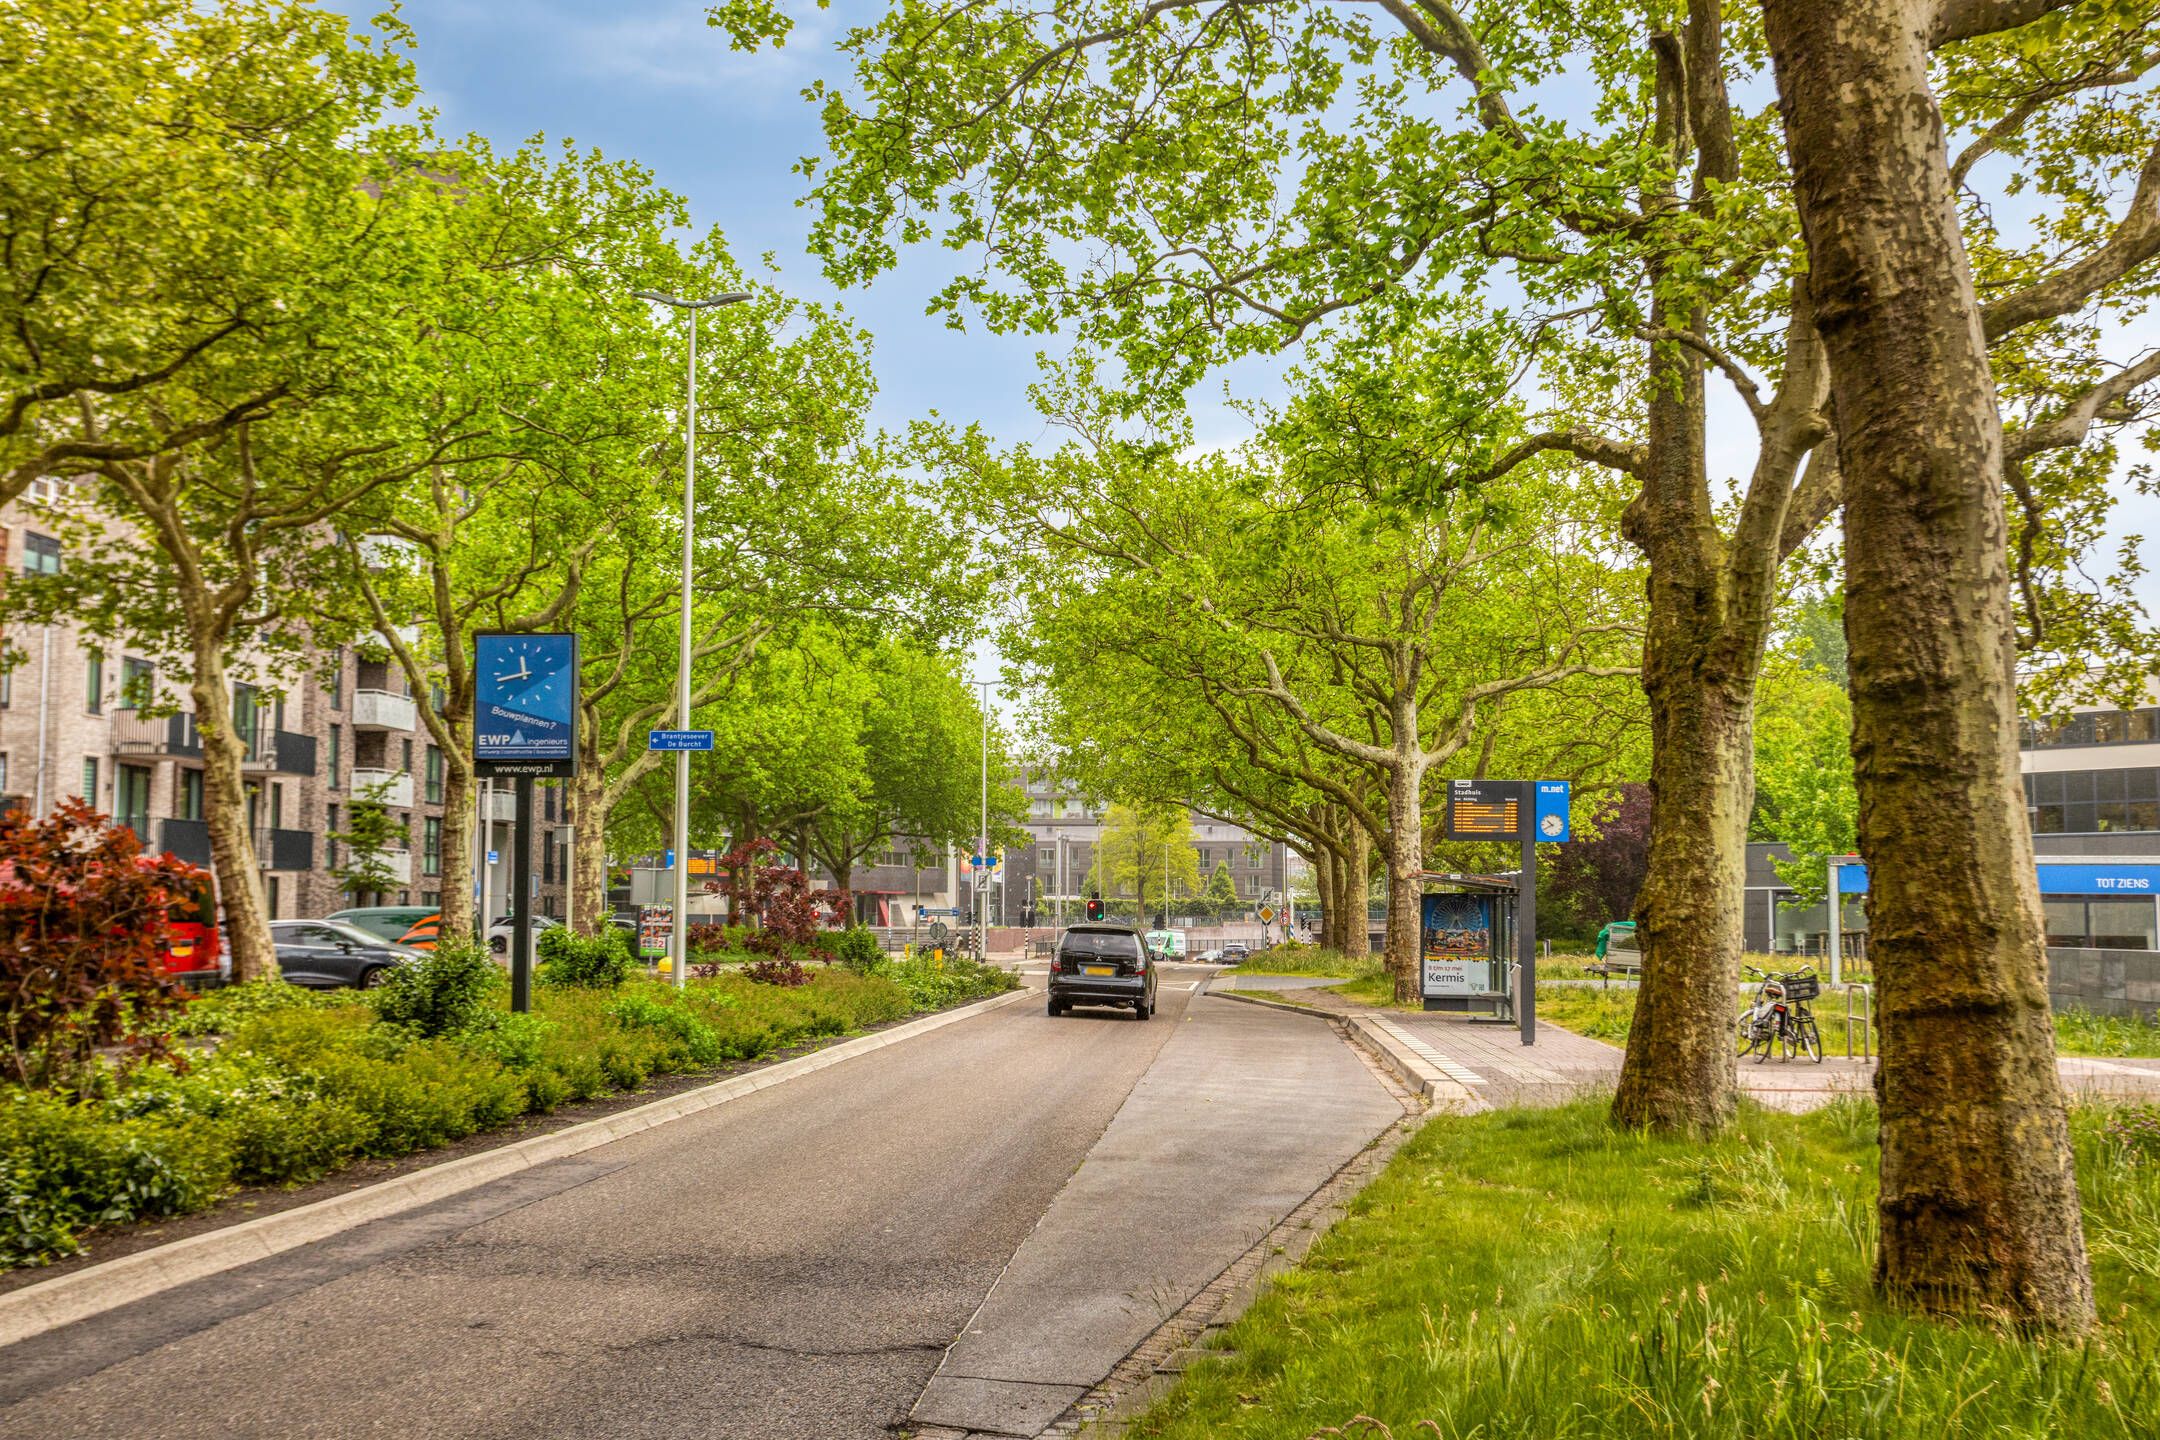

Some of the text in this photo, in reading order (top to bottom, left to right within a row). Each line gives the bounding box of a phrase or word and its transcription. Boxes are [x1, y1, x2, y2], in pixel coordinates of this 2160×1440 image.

[479, 735, 568, 747] EWP ingenieurs
[661, 733, 708, 741] Brantjesoever
[494, 764, 553, 775] www.ewp.nl
[1540, 785, 1564, 793] m.net
[2095, 878, 2150, 889] TOT ZIENS
[1428, 972, 1465, 982] Kermis
